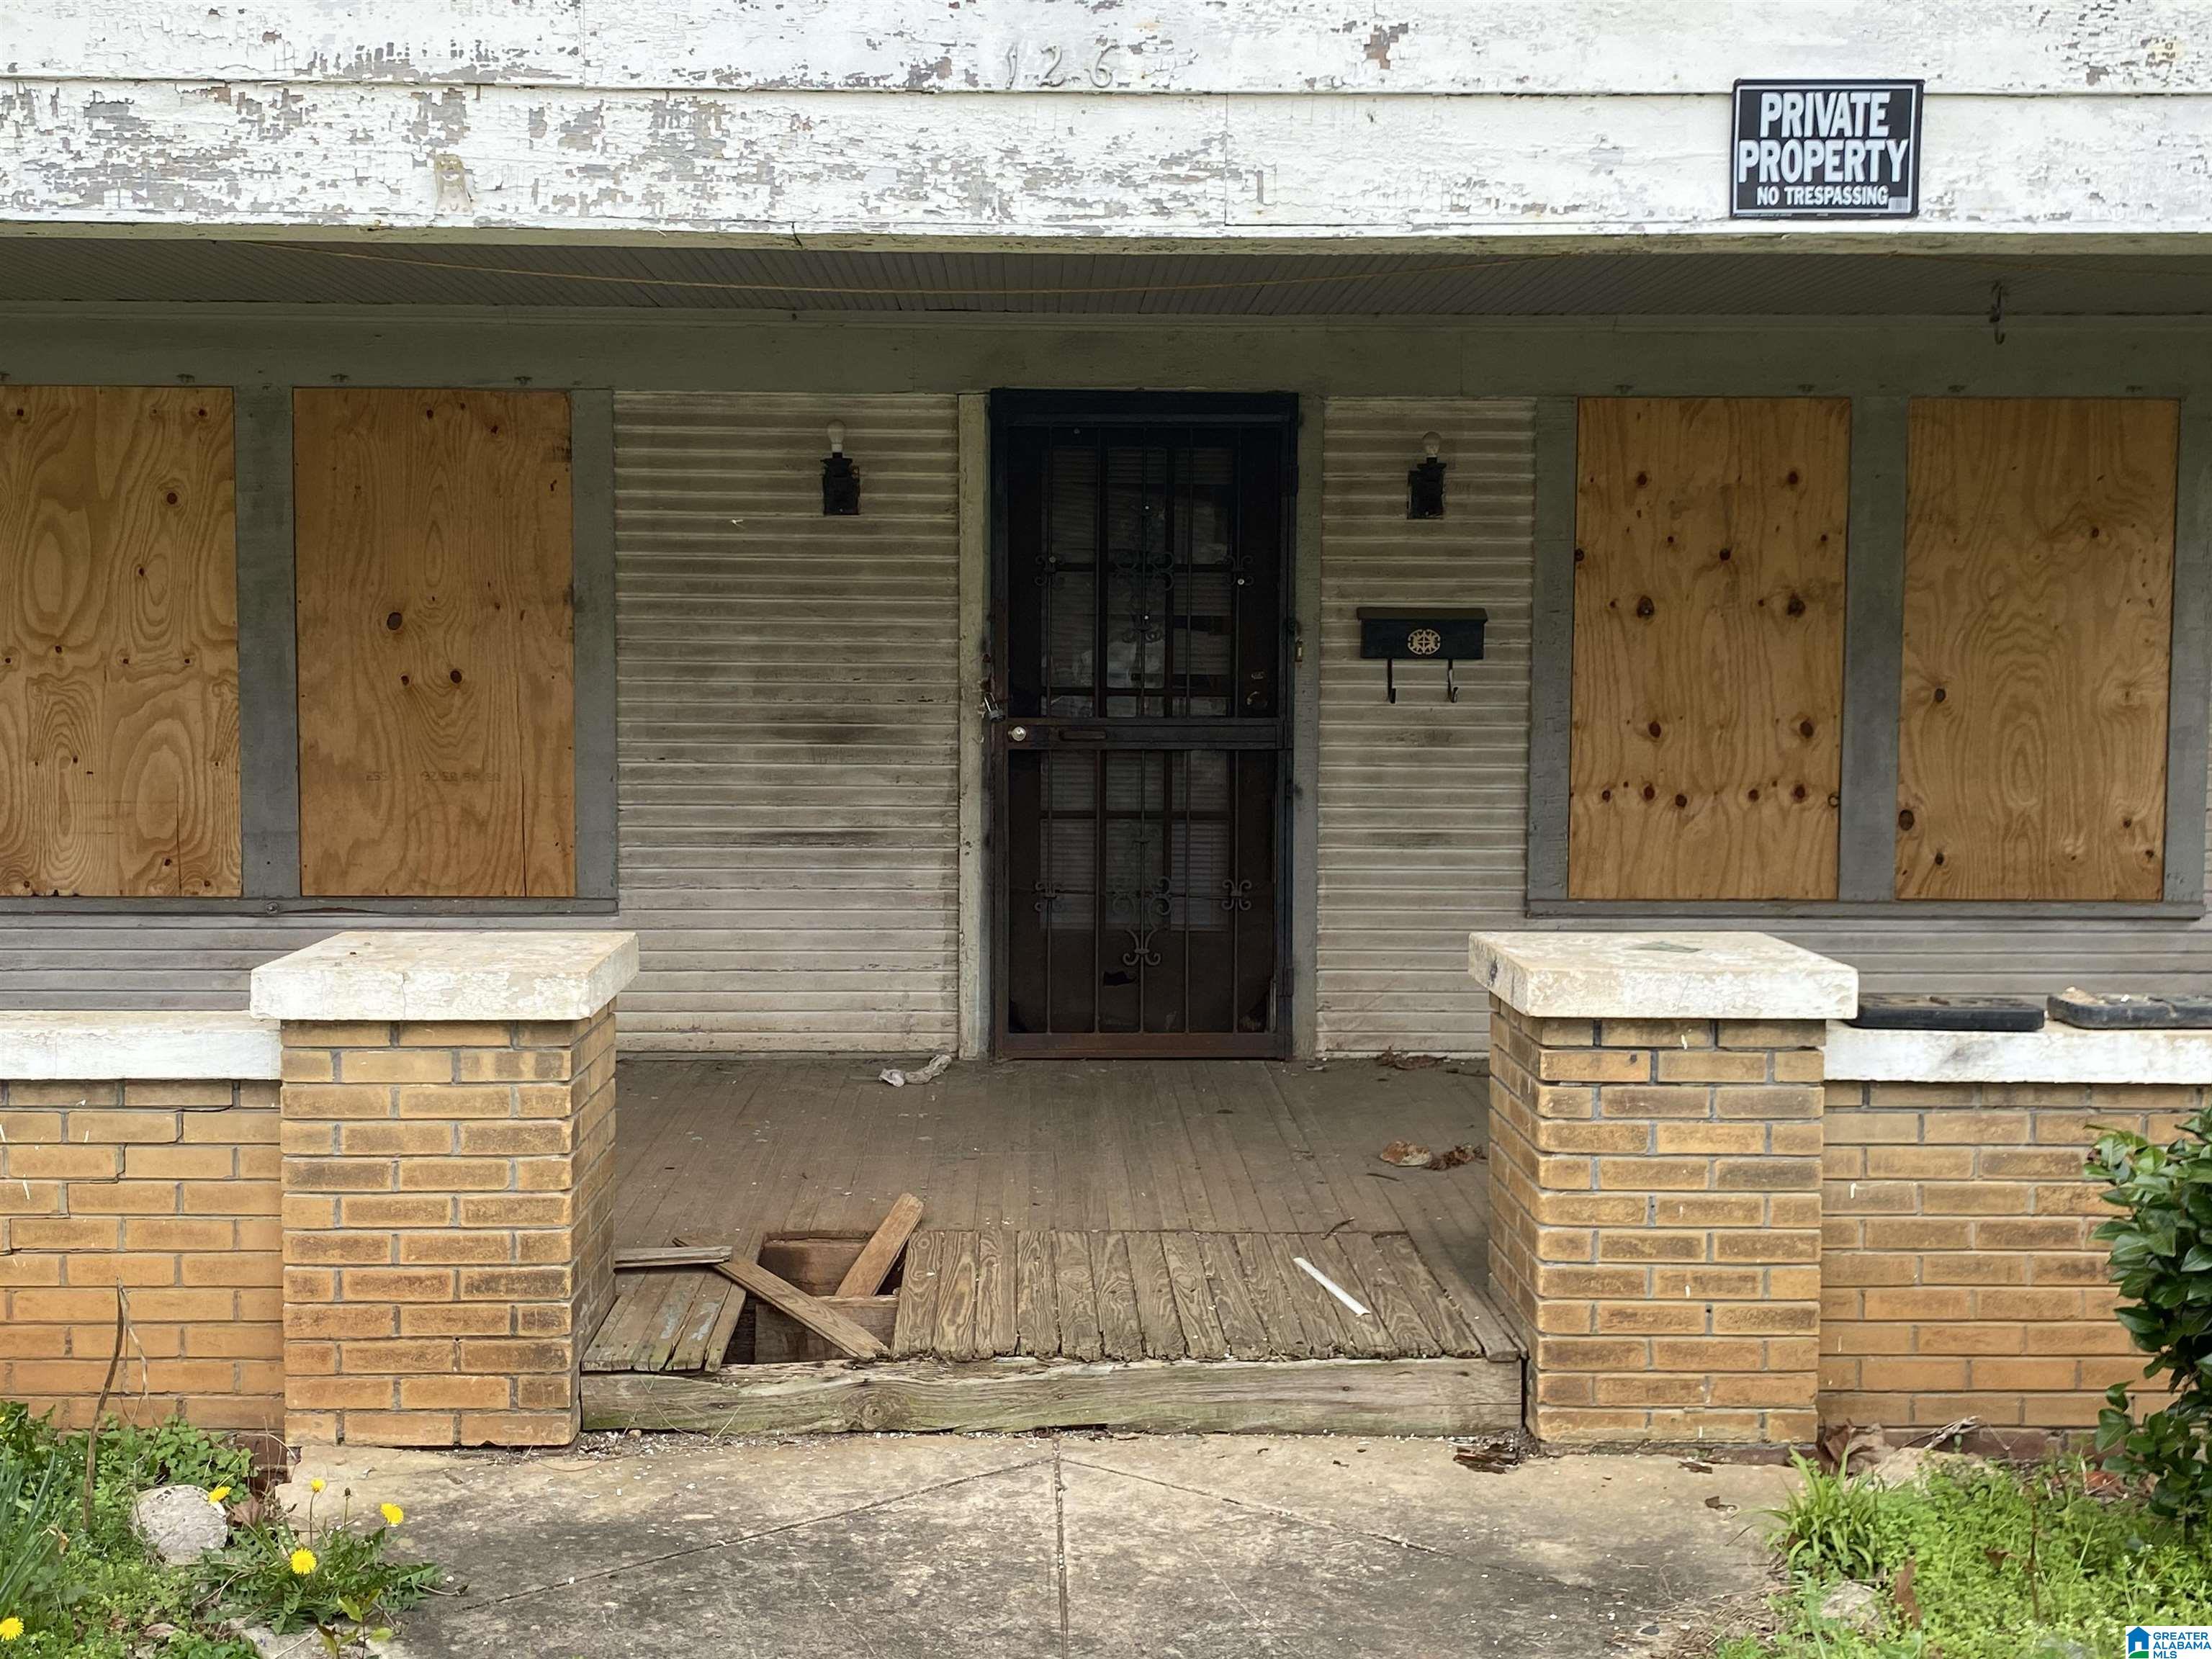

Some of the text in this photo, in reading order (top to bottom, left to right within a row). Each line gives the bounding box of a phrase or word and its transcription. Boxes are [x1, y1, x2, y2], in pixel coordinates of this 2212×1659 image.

[1759, 91, 1892, 138] PRIVATE
[1737, 138, 1910, 184] PROPERTY
[1756, 185, 1889, 206] NO TRESPASSING
